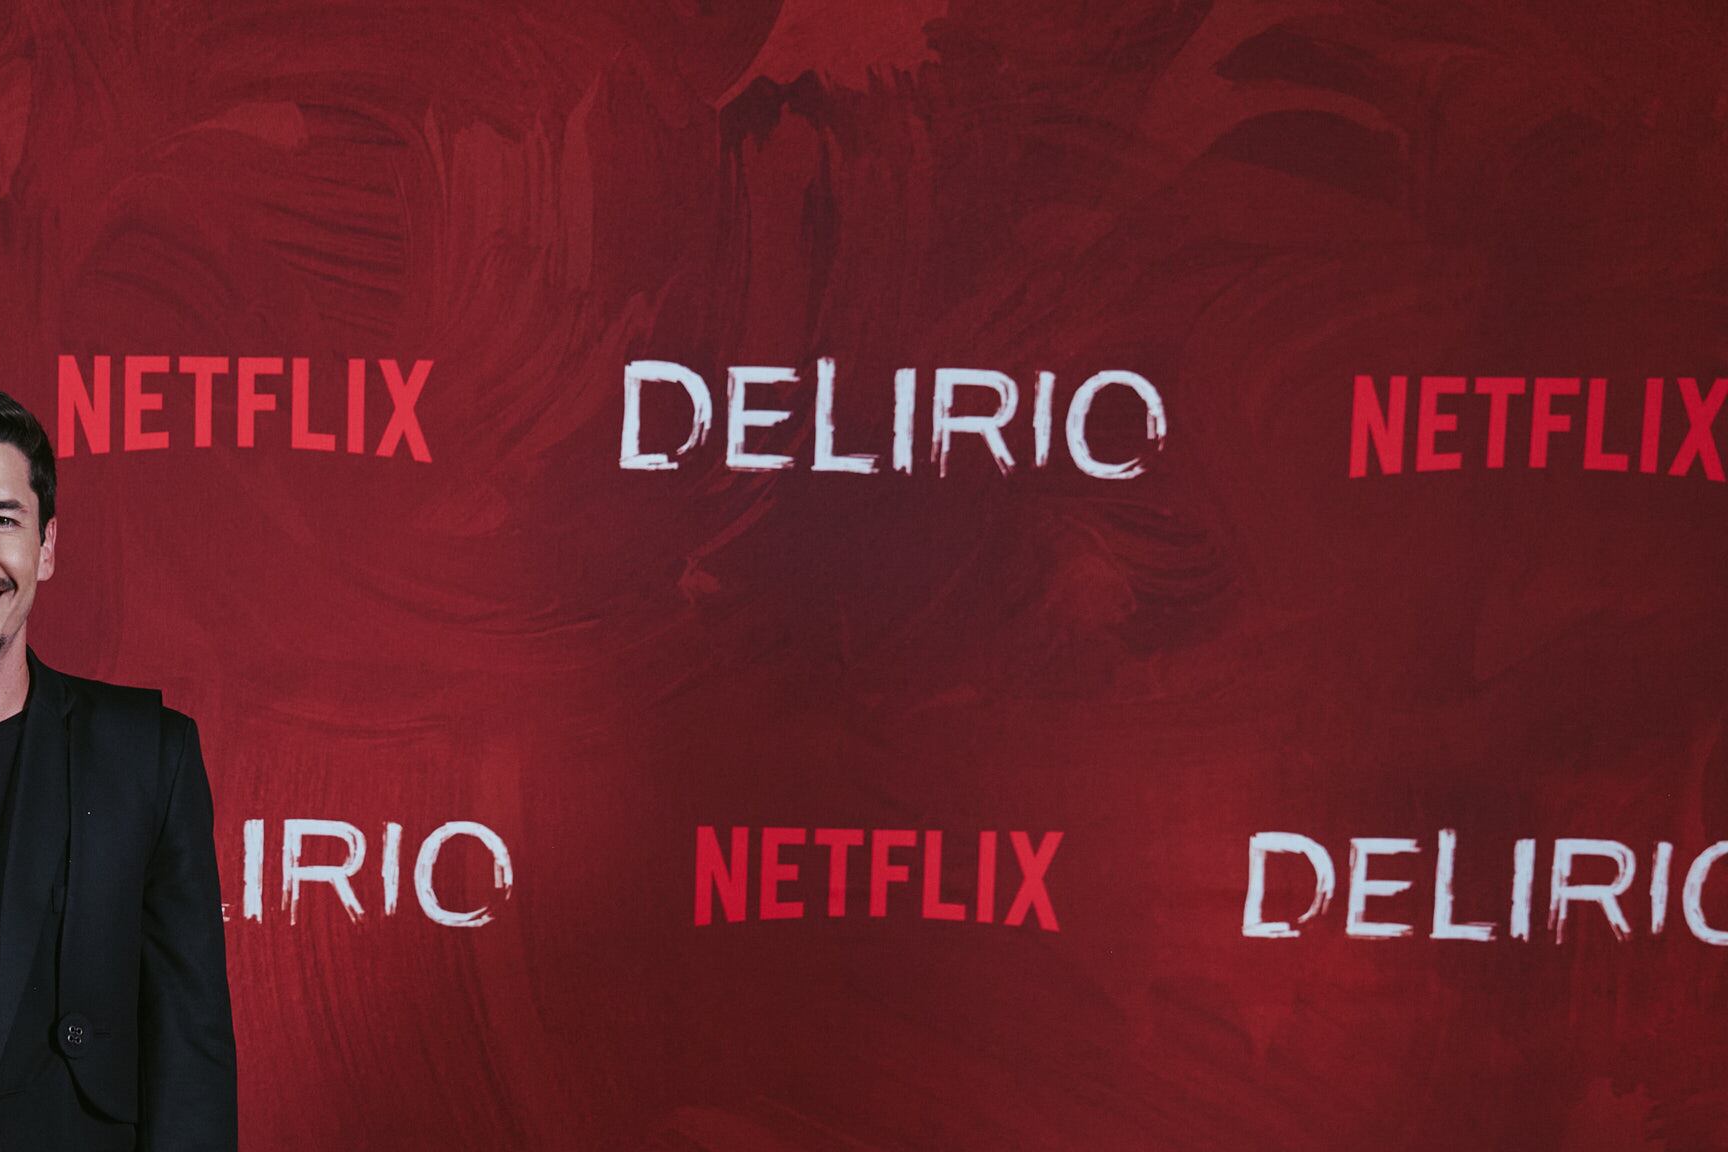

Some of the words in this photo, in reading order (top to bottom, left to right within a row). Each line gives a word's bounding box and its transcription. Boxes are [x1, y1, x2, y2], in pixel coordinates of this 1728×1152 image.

[57, 354, 436, 464] NETFLIX
[617, 357, 1169, 480] DELIRIO
[1349, 375, 1728, 481] NETFLIX
[221, 817, 515, 928] IRIO
[694, 826, 1065, 933] NETFLIX
